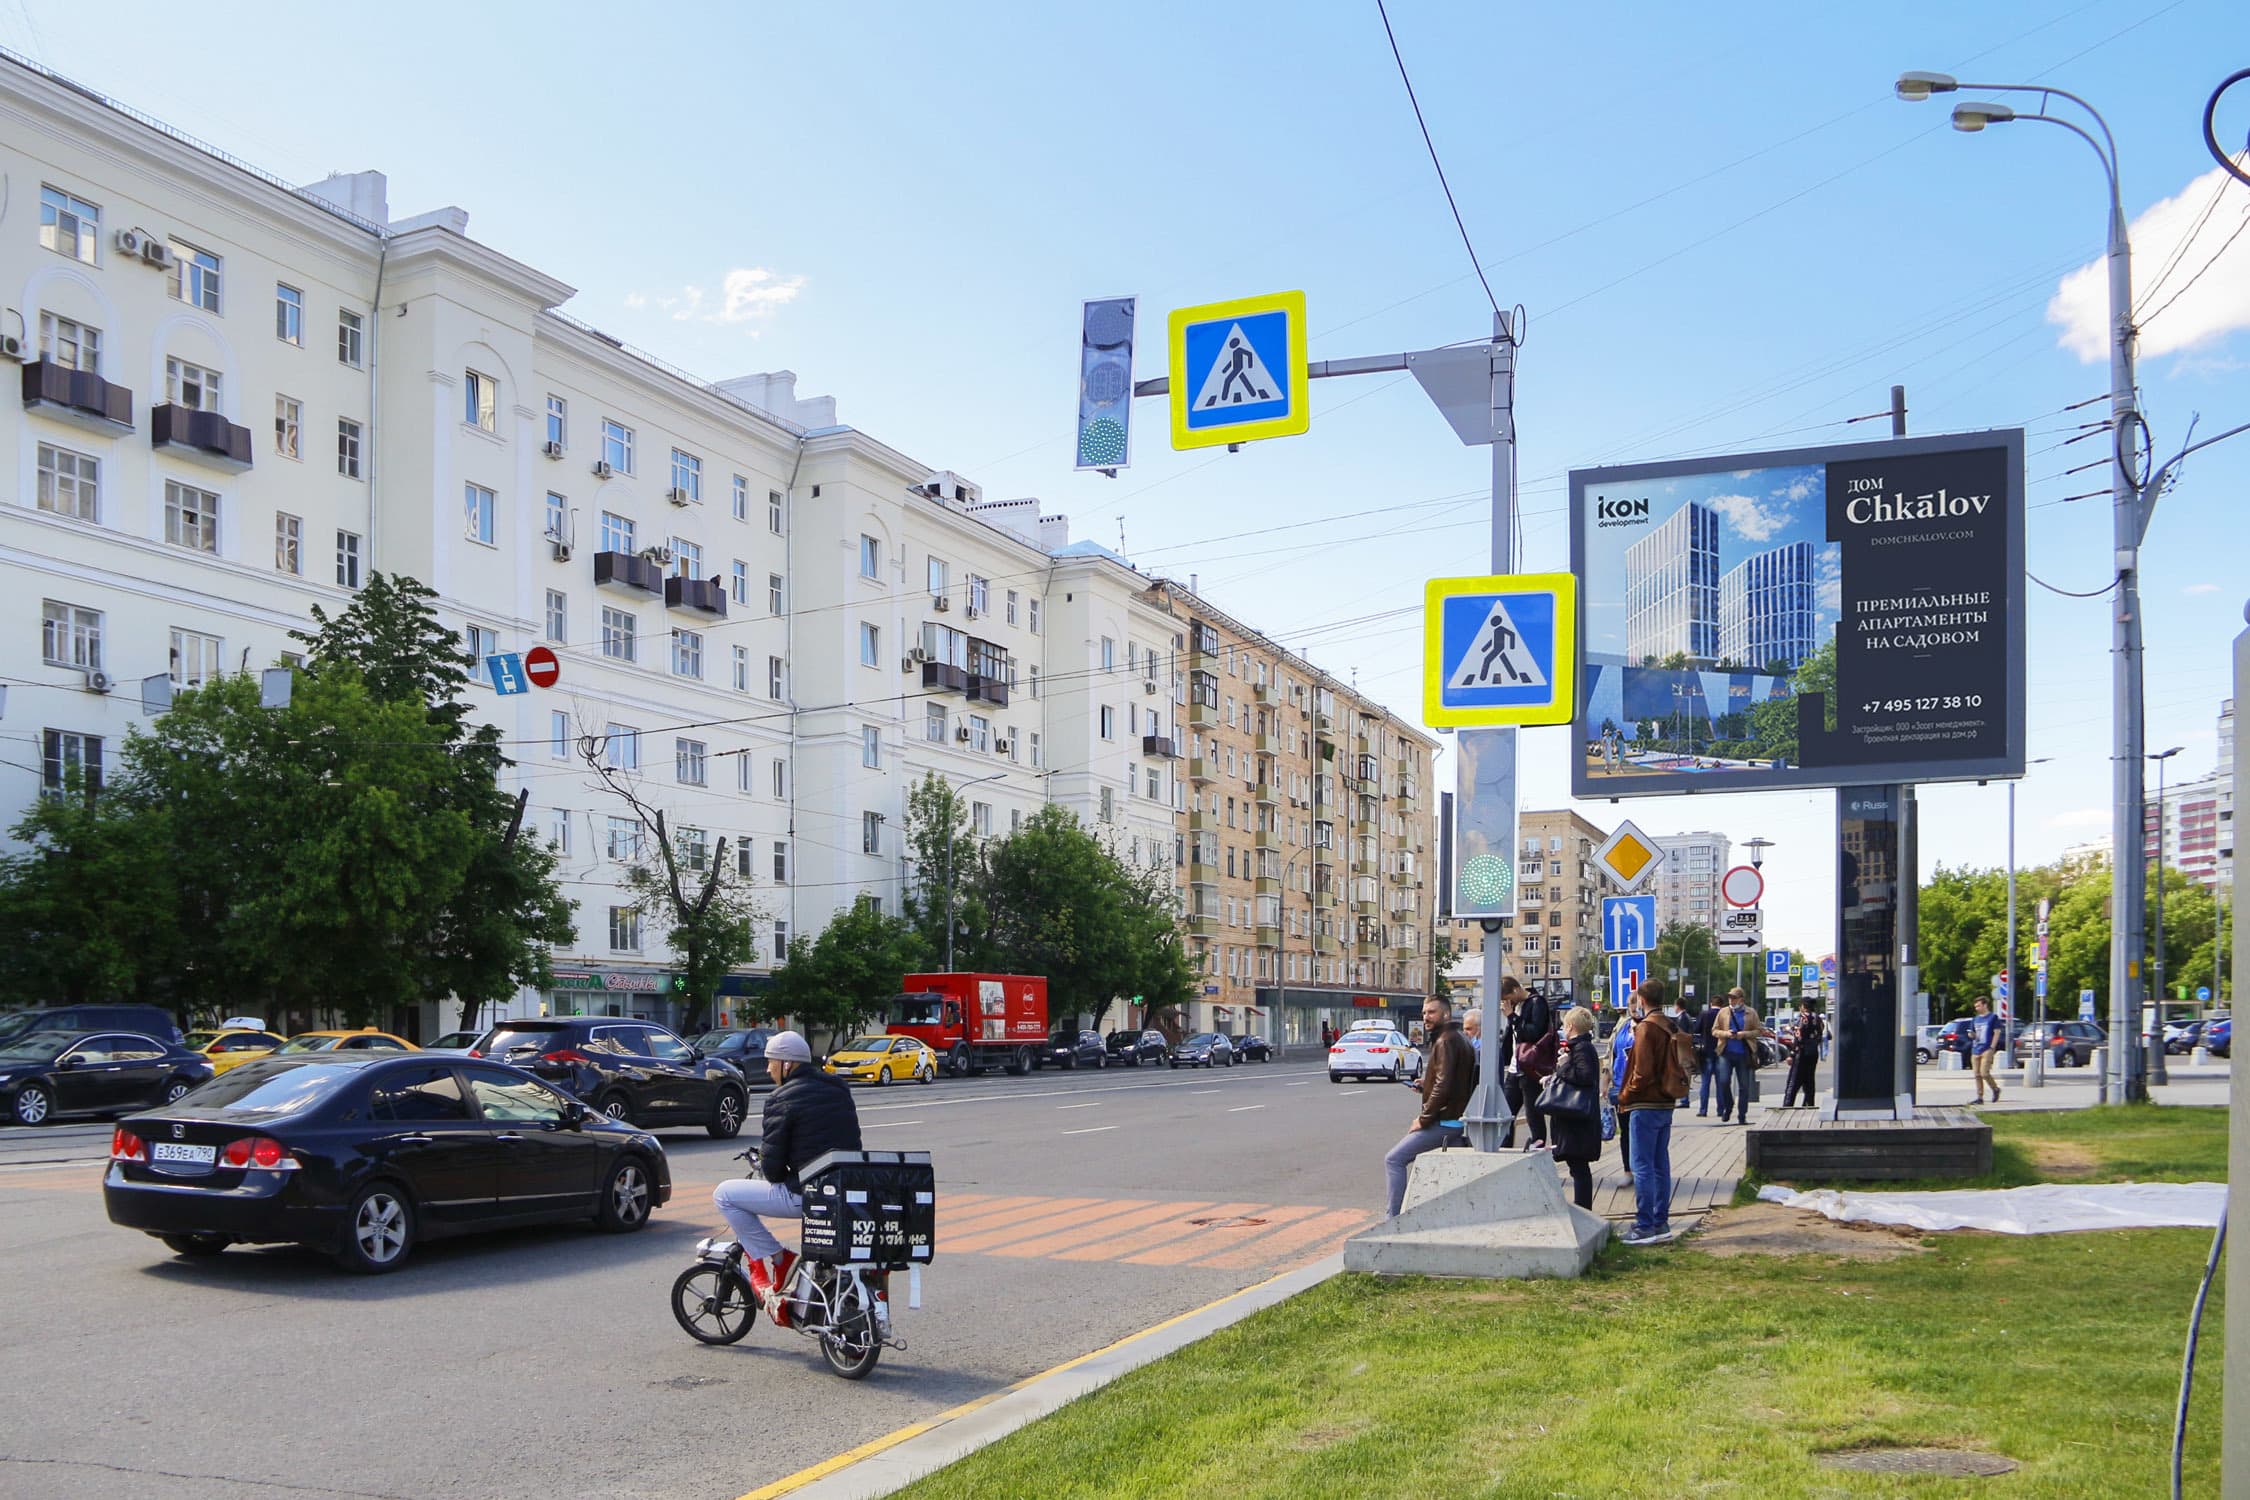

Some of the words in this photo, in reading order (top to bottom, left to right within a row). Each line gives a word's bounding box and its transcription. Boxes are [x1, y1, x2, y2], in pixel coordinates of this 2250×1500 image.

[1846, 488, 1991, 524] Chkālov
[1598, 517, 1649, 528] development
[1871, 529, 1974, 547] DOMCHKALOV.COM
[1856, 591, 1991, 613] ПРЕМИАЛЬНЫЕ
[1857, 611, 1988, 631] АПАРТАМЕНТЫ
[1866, 636, 1891, 649] НА
[1893, 630, 1980, 649] САДОВОМ
[1862, 701, 1881, 713] +7
[1884, 699, 1912, 712] 495
[1915, 697, 1939, 710] 127
[1942, 696, 1962, 709] 38
[1965, 695, 1982, 707] 10
[1863, 800, 1889, 811] Russ
[1772, 953, 1785, 971] P
